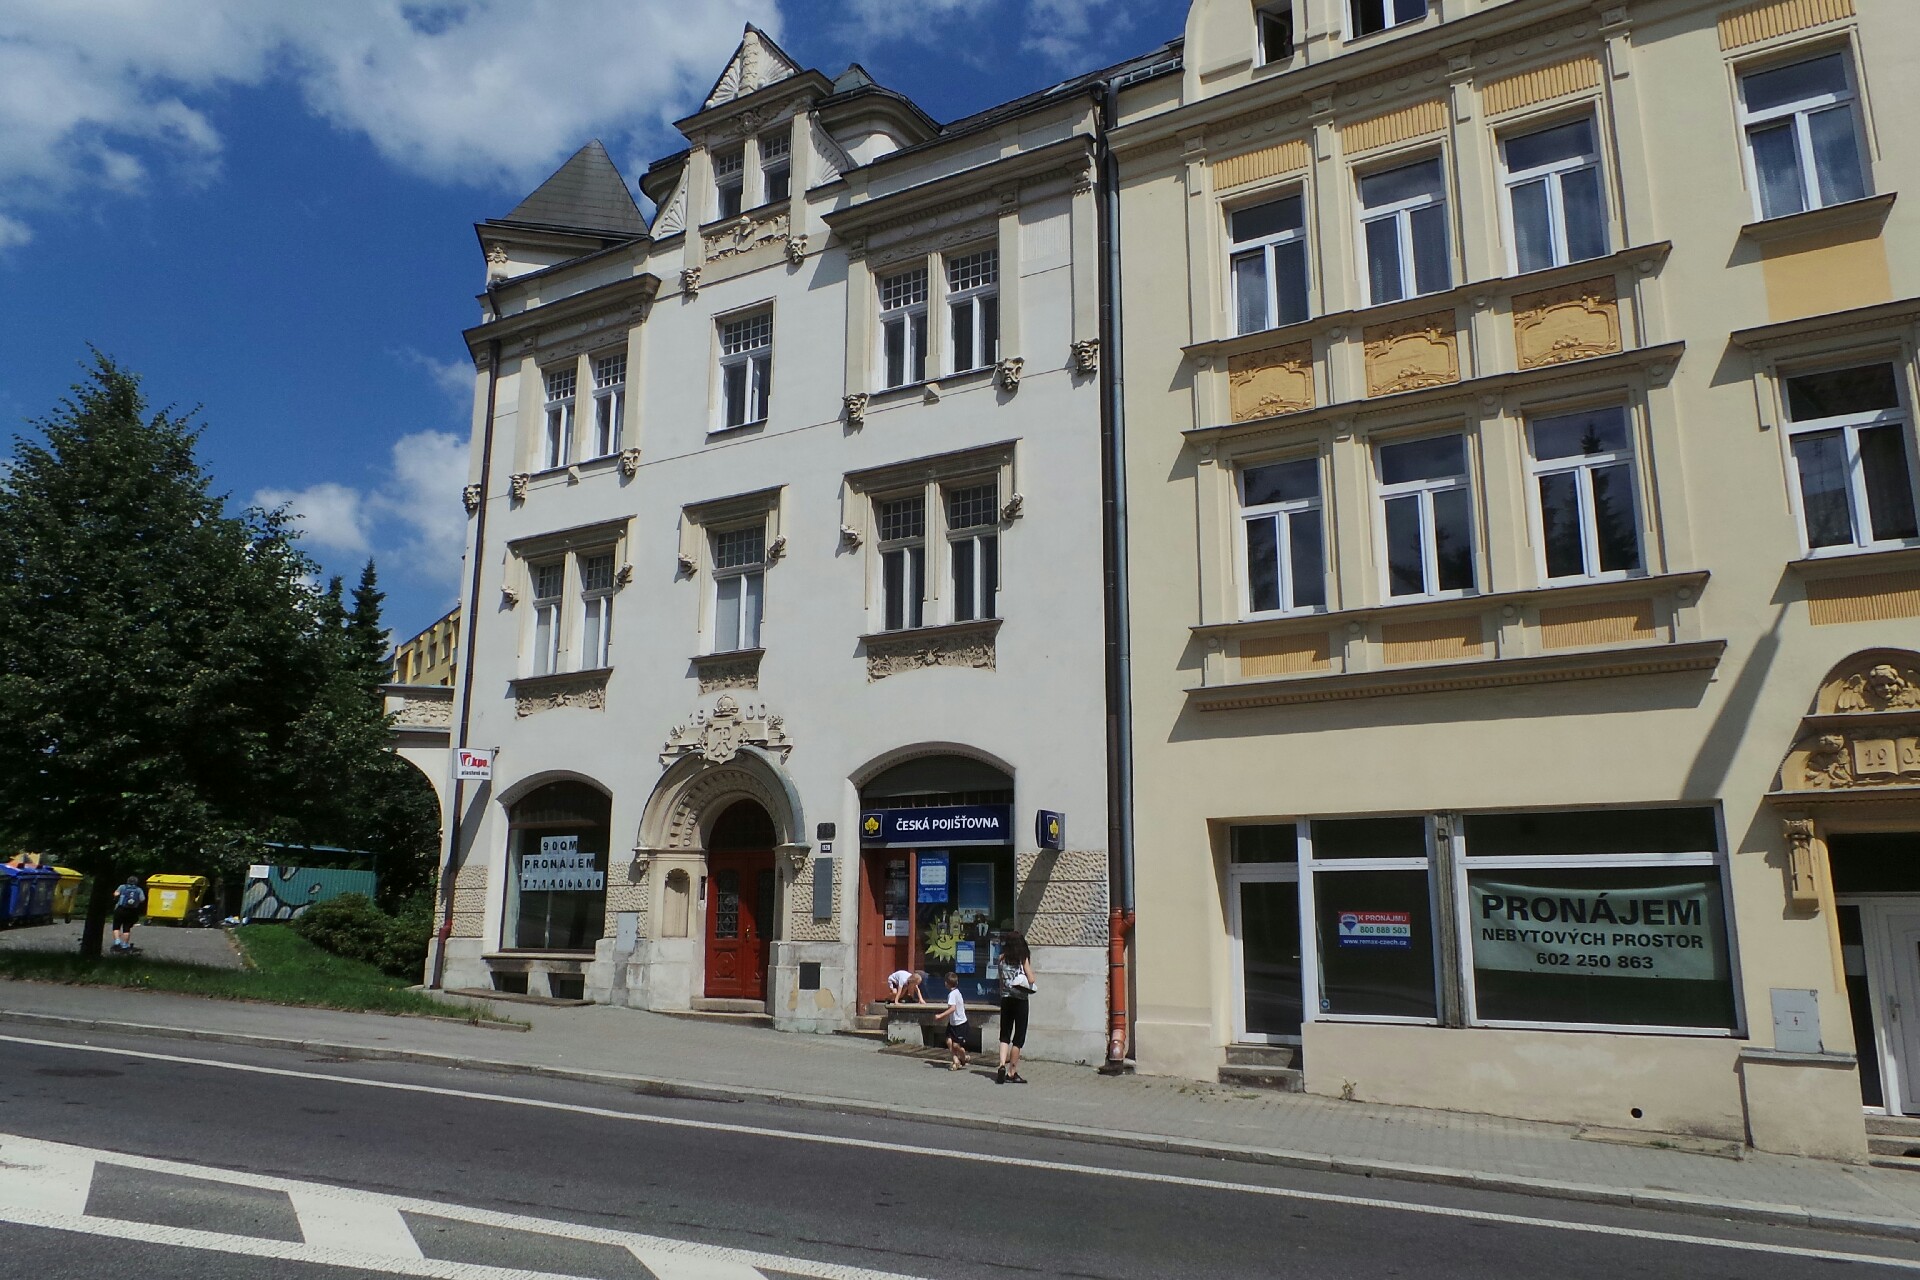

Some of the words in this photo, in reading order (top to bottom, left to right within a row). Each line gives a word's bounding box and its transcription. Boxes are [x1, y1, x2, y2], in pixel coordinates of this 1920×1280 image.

[1903, 748, 1920, 765] 0
[896, 817, 930, 831] ČESKÁ
[932, 815, 999, 830] POJIŠŤOVNA
[524, 857, 594, 869] PRONÁJEM
[1482, 893, 1701, 926] PRONÁJEM
[1360, 926, 1374, 934] 800
[1376, 926, 1391, 934] 888
[1392, 926, 1407, 934] 503
[1482, 928, 1605, 946] NEBYTOVÝCH
[1612, 933, 1703, 949] PROSTOR
[1537, 952, 1570, 966] 602
[1576, 954, 1611, 968] 250
[1618, 956, 1653, 969] 863
